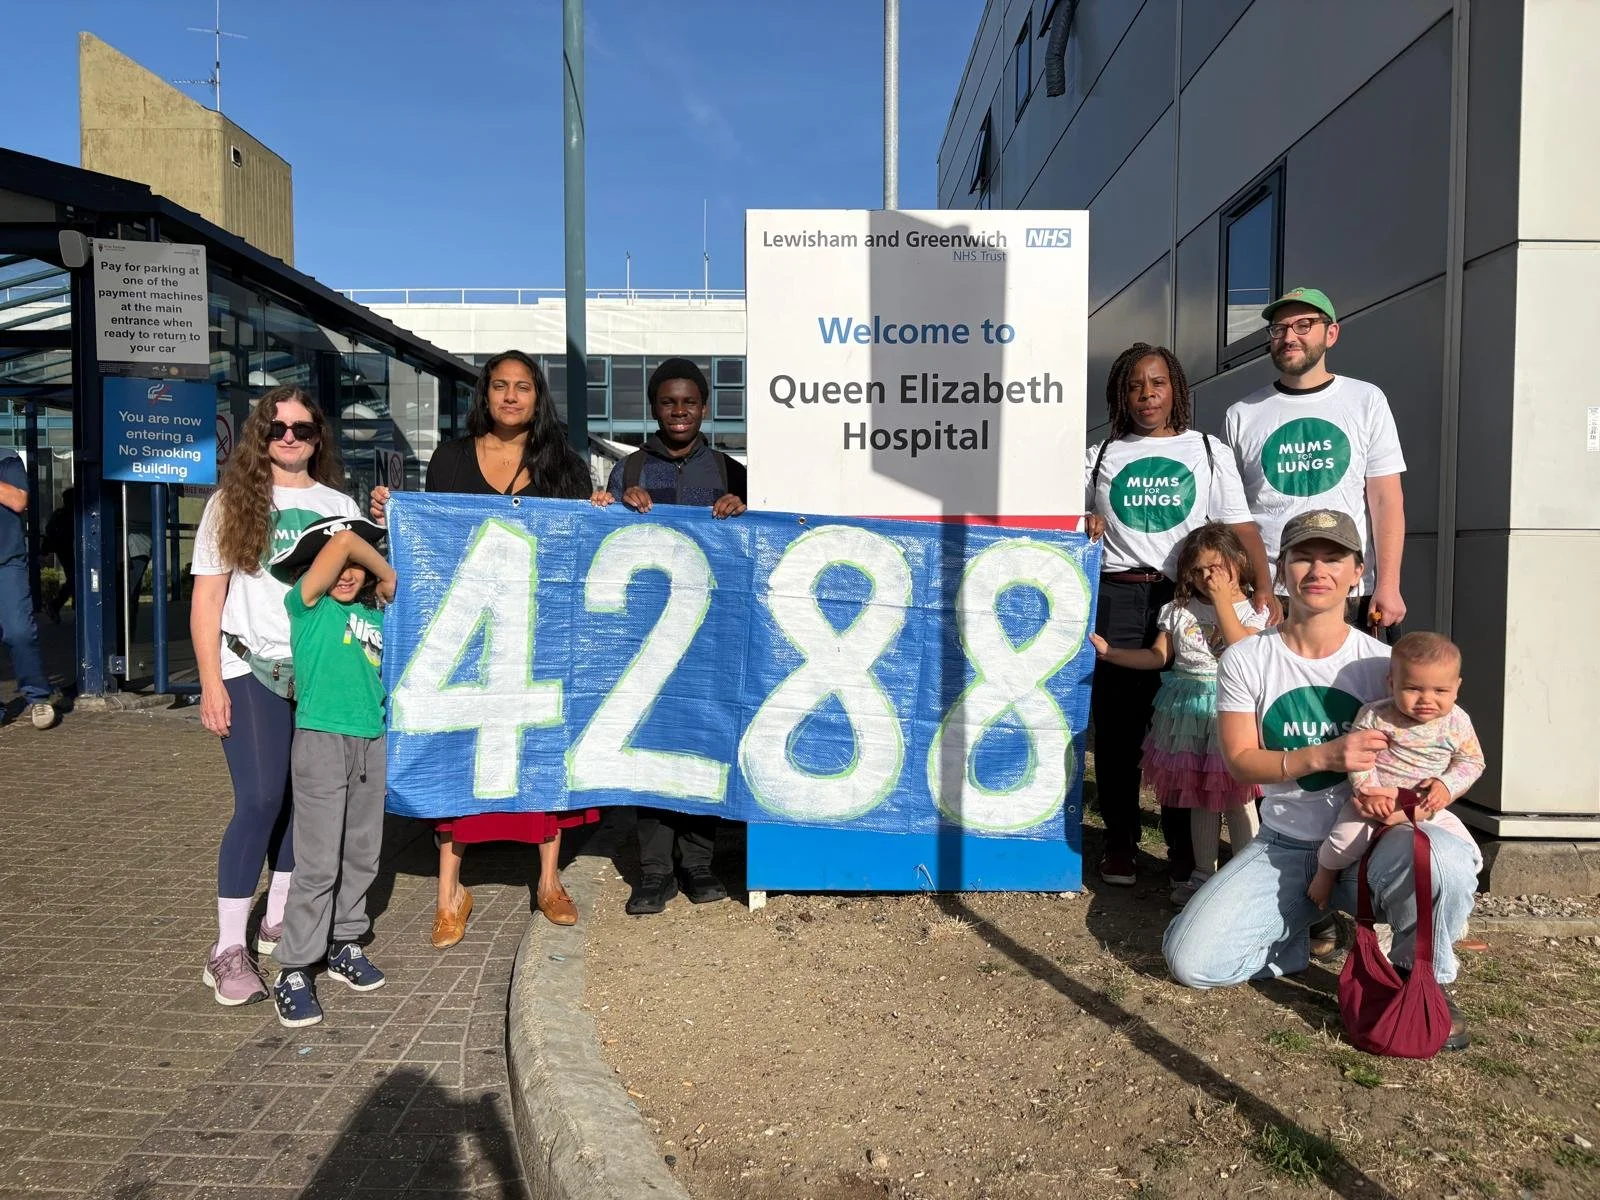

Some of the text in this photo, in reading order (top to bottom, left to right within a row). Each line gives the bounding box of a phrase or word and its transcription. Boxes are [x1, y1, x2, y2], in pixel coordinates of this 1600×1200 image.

[763, 230, 1007, 248] Lewisham and Greenwich
[1027, 229, 1070, 247] NHS
[953, 250, 1007, 261] NHS Trust
[101, 261, 200, 276] Pay for parking at
[122, 277, 179, 287] one of the
[98, 289, 204, 301] payment machines
[121, 303, 183, 313] at the main
[111, 316, 193, 328] entrance when
[104, 330, 201, 341] ready to return to
[818, 316, 1016, 345] Welcome to
[130, 344, 177, 354] your car
[769, 373, 1063, 409] Queen Elizabeth
[119, 410, 202, 427] You are now
[126, 429, 194, 444] entering a
[843, 420, 989, 457] Hospital
[119, 445, 201, 462] No Smoking
[1279, 440, 1332, 454] MUMS
[132, 461, 188, 477] Building
[1277, 458, 1334, 473] LUNGS
[1127, 476, 1180, 488] MUMS
[1123, 494, 1181, 507] LUNGS
[274, 528, 302, 541] MU
[390, 517, 1092, 833] 4288
[1283, 721, 1352, 737] MUMS
